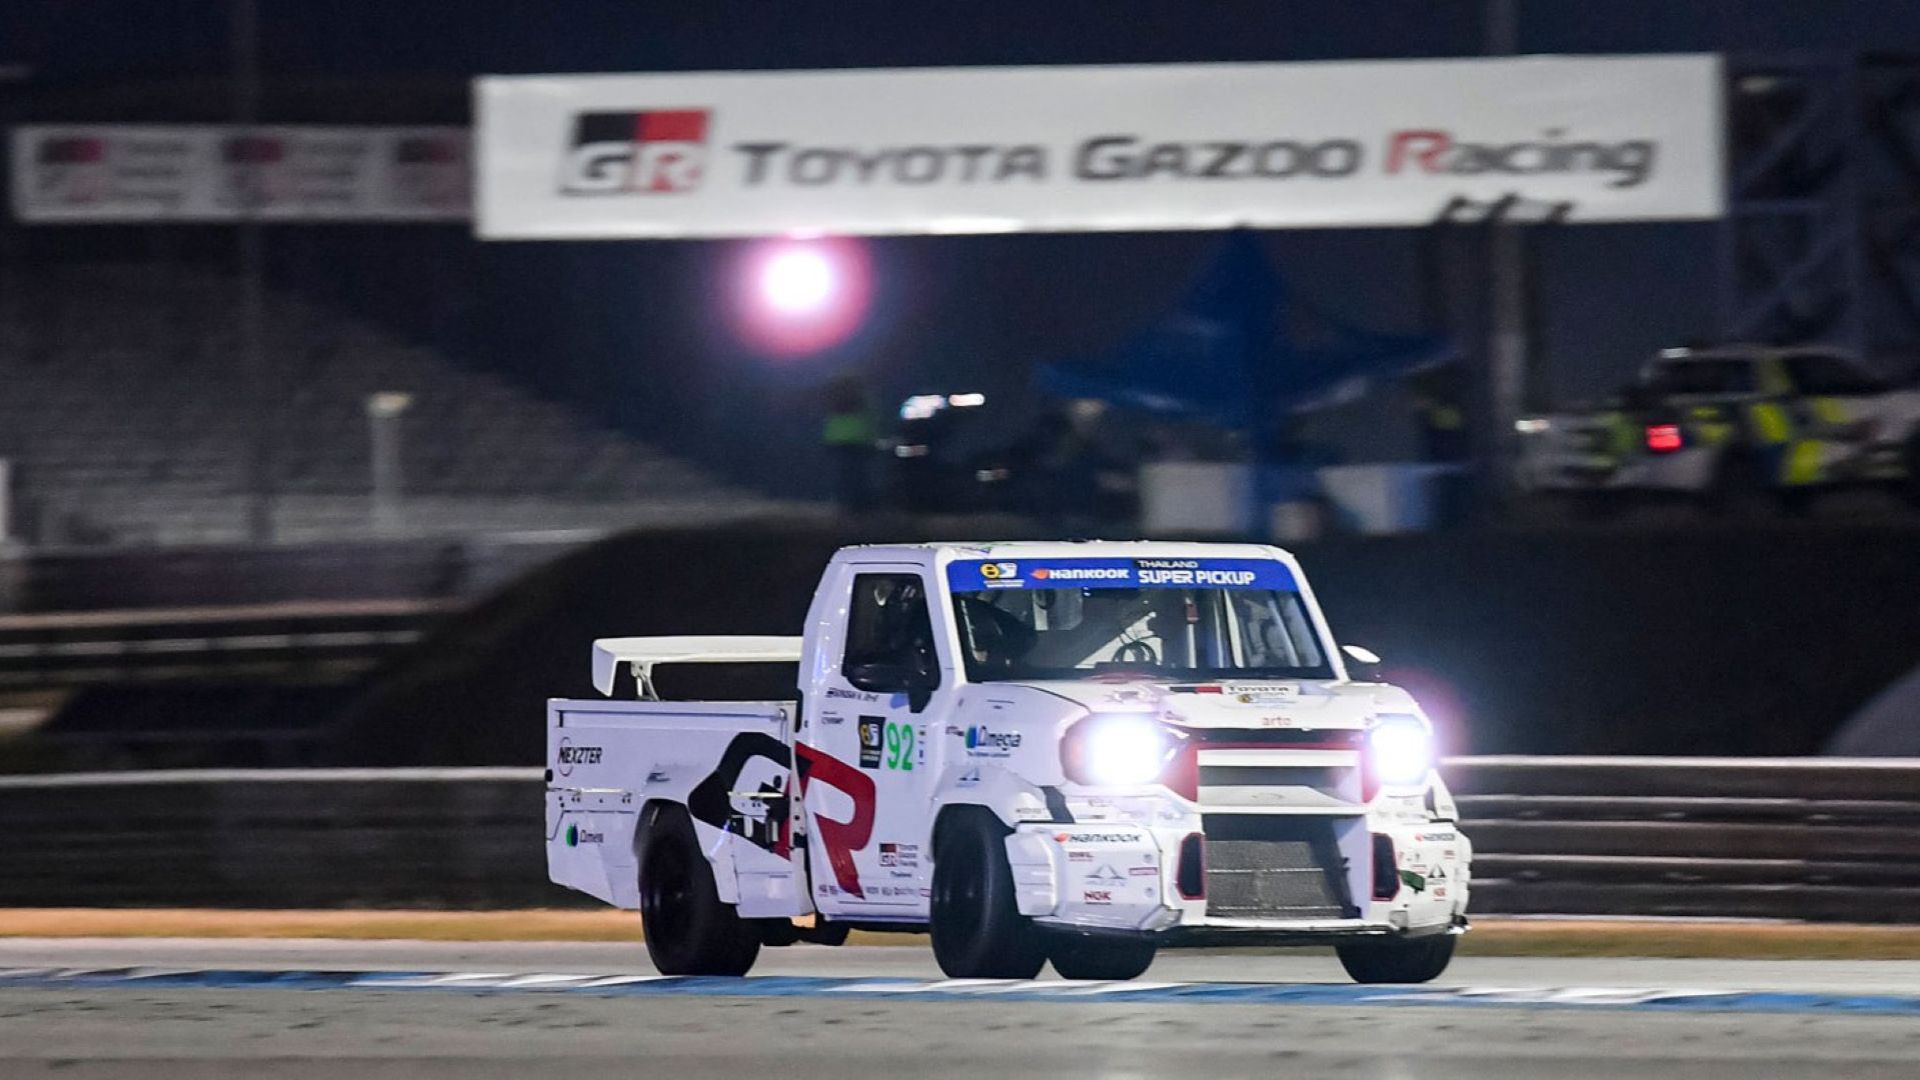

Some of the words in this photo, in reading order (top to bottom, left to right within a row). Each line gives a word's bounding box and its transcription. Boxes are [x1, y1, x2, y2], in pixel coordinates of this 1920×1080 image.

[732, 141, 1047, 186] TOYOTA
[1073, 134, 1363, 182] GAZOO
[1383, 127, 1658, 190] Racing
[1137, 559, 1199, 569] THAILAND
[1138, 569, 1195, 585] SUPER
[1196, 570, 1256, 586] PICKUP
[886, 722, 914, 771] 92
